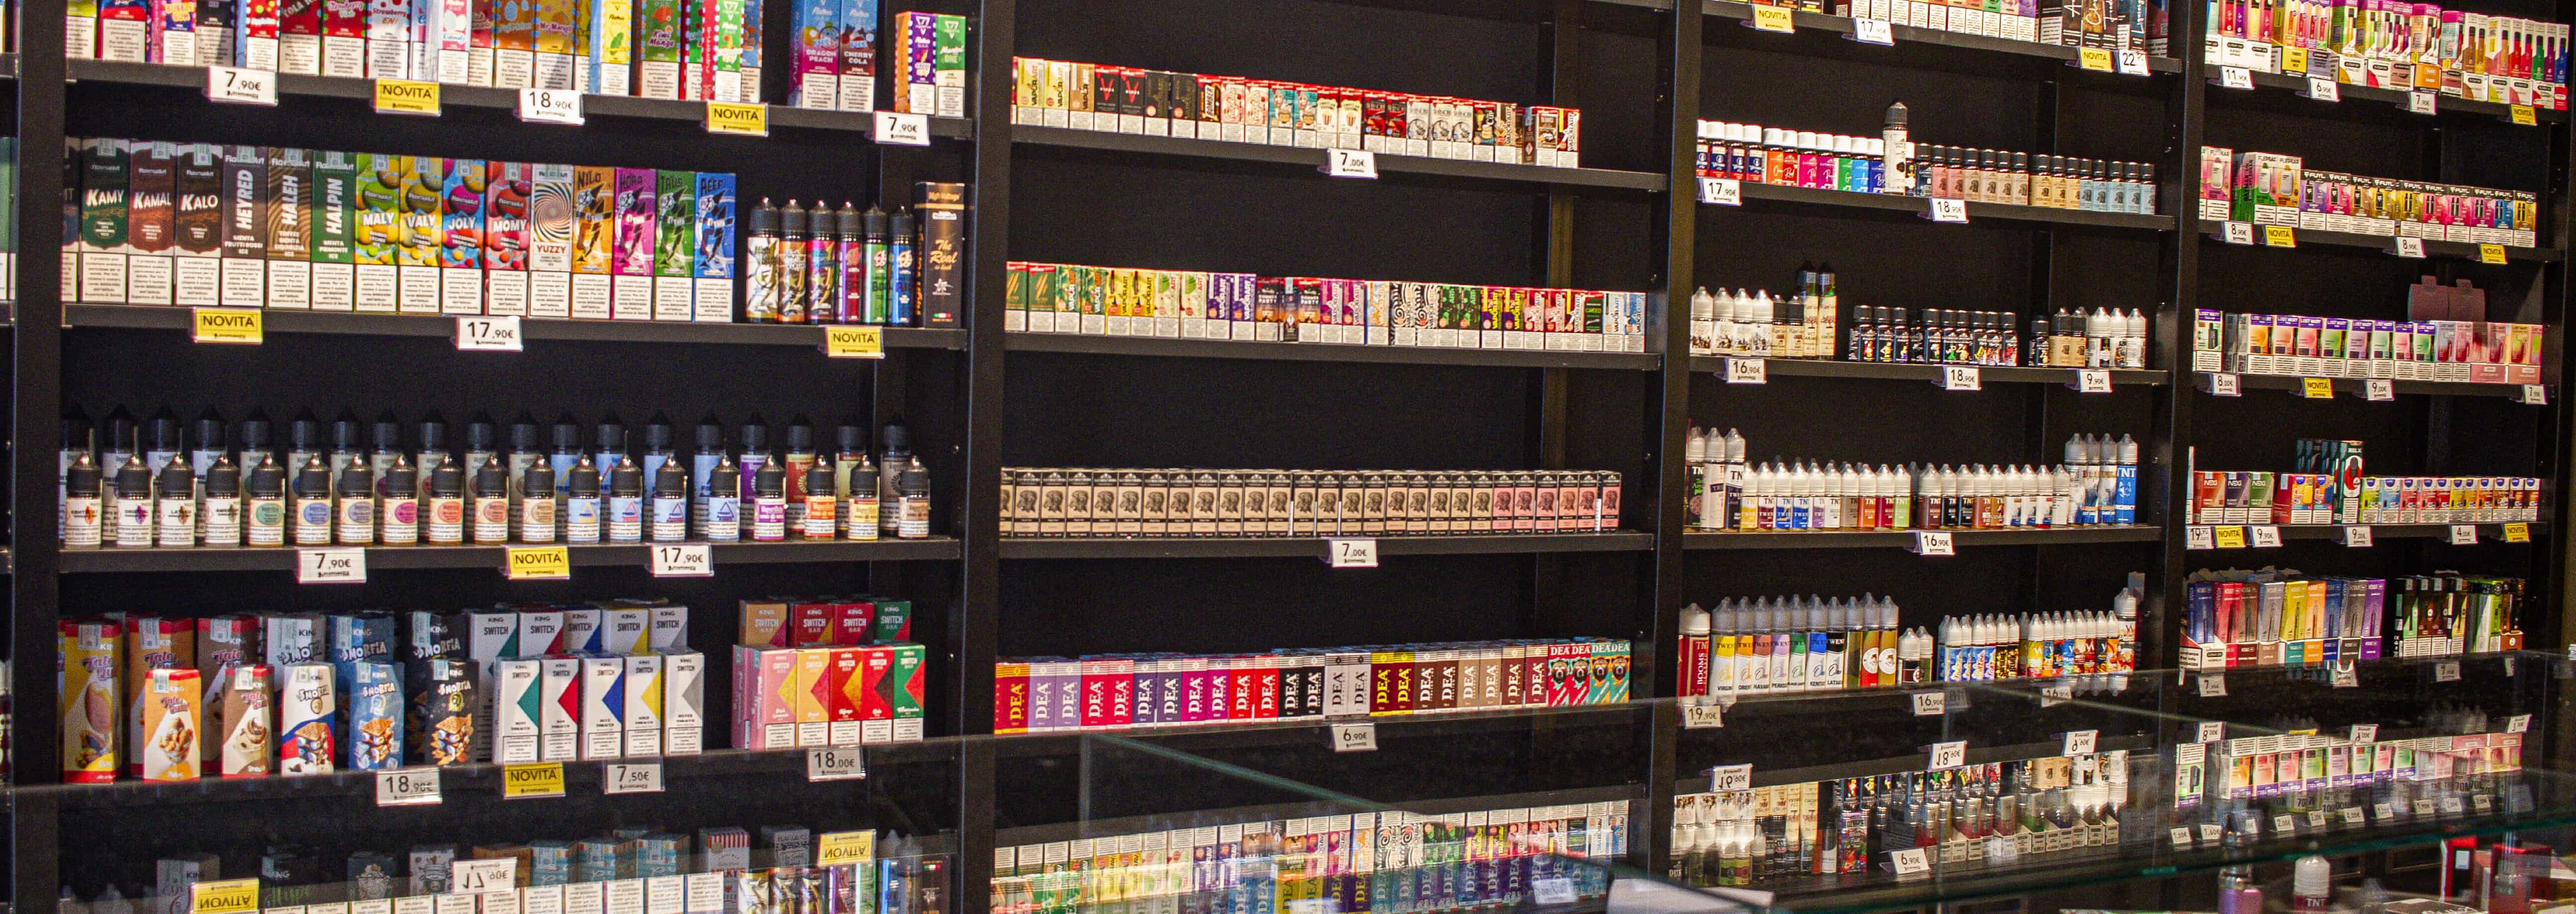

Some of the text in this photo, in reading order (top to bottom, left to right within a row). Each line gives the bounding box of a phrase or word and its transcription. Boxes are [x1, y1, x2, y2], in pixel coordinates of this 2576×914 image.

[373, 8, 406, 17] Strawberry
[649, 37, 675, 48] Mango
[226, 71, 261, 91] 7,90€
[529, 92, 573, 110] 18,90€
[889, 117, 917, 133] 7,90€
[1340, 153, 1364, 166] 7,00€
[87, 189, 124, 206] KAMY
[133, 192, 171, 209] KAMAL
[180, 194, 218, 211] KALO
[236, 170, 254, 230] HEYRED
[282, 175, 298, 225] HALEH
[326, 178, 343, 234] HALPIN
[363, 213, 395, 226] MALY
[408, 215, 436, 228] VALY
[448, 217, 475, 229] JOLY
[494, 219, 527, 232] MOMY
[537, 245, 566, 254] YUZZY
[935, 239, 952, 251] The
[929, 250, 957, 264] Real
[468, 322, 512, 338] 17,90€
[1733, 361, 1760, 374] 16,90€
[1951, 370, 1974, 383] 18,90€
[2117, 468, 2137, 478] TNT
[1924, 535, 1949, 547] 16,90€
[661, 547, 703, 564] 17,90€
[1342, 544, 1366, 557] 7,00€
[315, 553, 351, 569] 7,90€
[569, 623, 593, 632] SWITCH
[617, 623, 640, 632] SWITCH
[656, 620, 679, 629] SWITCH
[755, 619, 779, 627] SWITCH
[803, 619, 826, 627] SWITCH
[843, 618, 866, 627] SWITCH
[881, 615, 903, 624] SWITCH
[484, 626, 509, 635] SWITCH
[530, 625, 555, 633] SWITCH
[1550, 646, 1569, 655] DEA
[1572, 646, 1590, 655] DEA
[1592, 645, 1611, 653] DEA
[1612, 643, 1629, 652] DEA
[1376, 670, 1388, 703] DEA
[1398, 669, 1408, 702] DEA
[1420, 668, 1431, 701] DEA
[1442, 666, 1453, 700] DEA
[1464, 666, 1474, 699] DEA
[1486, 665, 1496, 698] DEA
[1508, 664, 1519, 697] DEA
[1532, 663, 1542, 695] DEA
[1165, 678, 1177, 714] DEA
[1189, 678, 1201, 713] DEA
[1213, 676, 1224, 711] DEA
[1236, 676, 1248, 710] DEA
[1261, 675, 1273, 709] DEA
[1285, 674, 1296, 708] DEA
[1307, 673, 1319, 707] DEA
[1332, 672, 1343, 705] DEA
[1355, 672, 1364, 704] DEA
[1010, 683, 1022, 719] DEA
[1036, 682, 1048, 719] DEA
[1063, 682, 1075, 718] DEA
[1089, 681, 1101, 717] DEA
[1114, 680, 1126, 716] DEA
[1138, 679, 1150, 715] DEA
[1688, 708, 1717, 720] 19,90€
[814, 752, 854, 768] 18,00€
[617, 766, 649, 782] 7,50€
[386, 776, 433, 793] 18,90€
[2306, 899, 2324, 907] TNT
